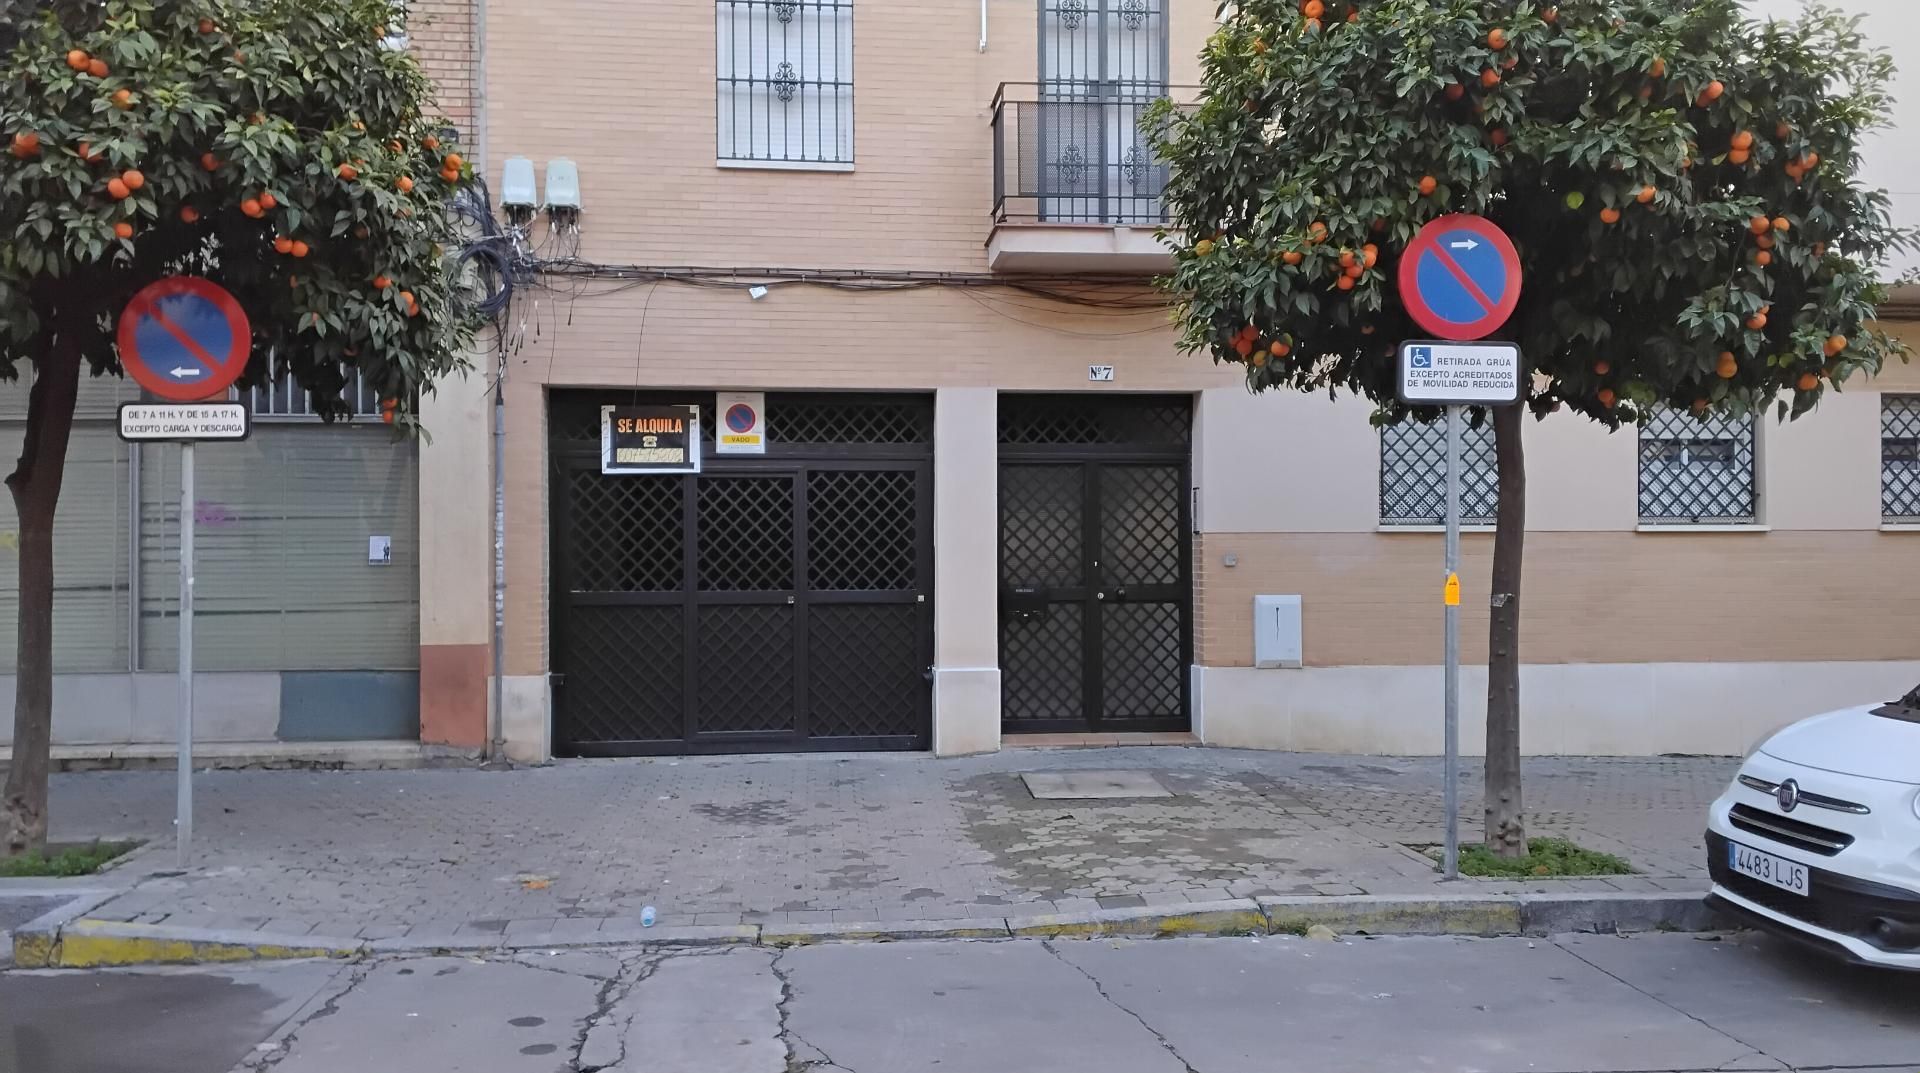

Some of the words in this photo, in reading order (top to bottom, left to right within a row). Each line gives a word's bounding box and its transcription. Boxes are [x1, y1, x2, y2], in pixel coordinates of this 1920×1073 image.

[1437, 357, 1481, 366] RETIRADA
[1486, 356, 1511, 367] GRÚA
[1103, 367, 1112, 379] 7
[1410, 370, 1450, 378] EXCEPTO
[1453, 371, 1513, 379] ACREDITADOS
[1407, 379, 1419, 387] DE
[1423, 380, 1468, 388] MOVILIDAD
[1472, 380, 1514, 389] REDUCIDA
[128, 411, 139, 419] DE
[142, 411, 147, 419] 7
[150, 411, 156, 419] A
[159, 411, 165, 419] 11
[178, 410, 184, 418] Y
[186, 410, 198, 418] DE
[201, 410, 209, 418] 15
[212, 410, 218, 418] A
[221, 410, 228, 418] 17
[124, 425, 161, 433] EXCEPTO
[201, 424, 243, 432] DESCARGA
[617, 418, 632, 433] SE
[635, 418, 683, 434] ALQUILA
[1738, 850, 1770, 878] 4483
[1775, 861, 1803, 890] LJS
